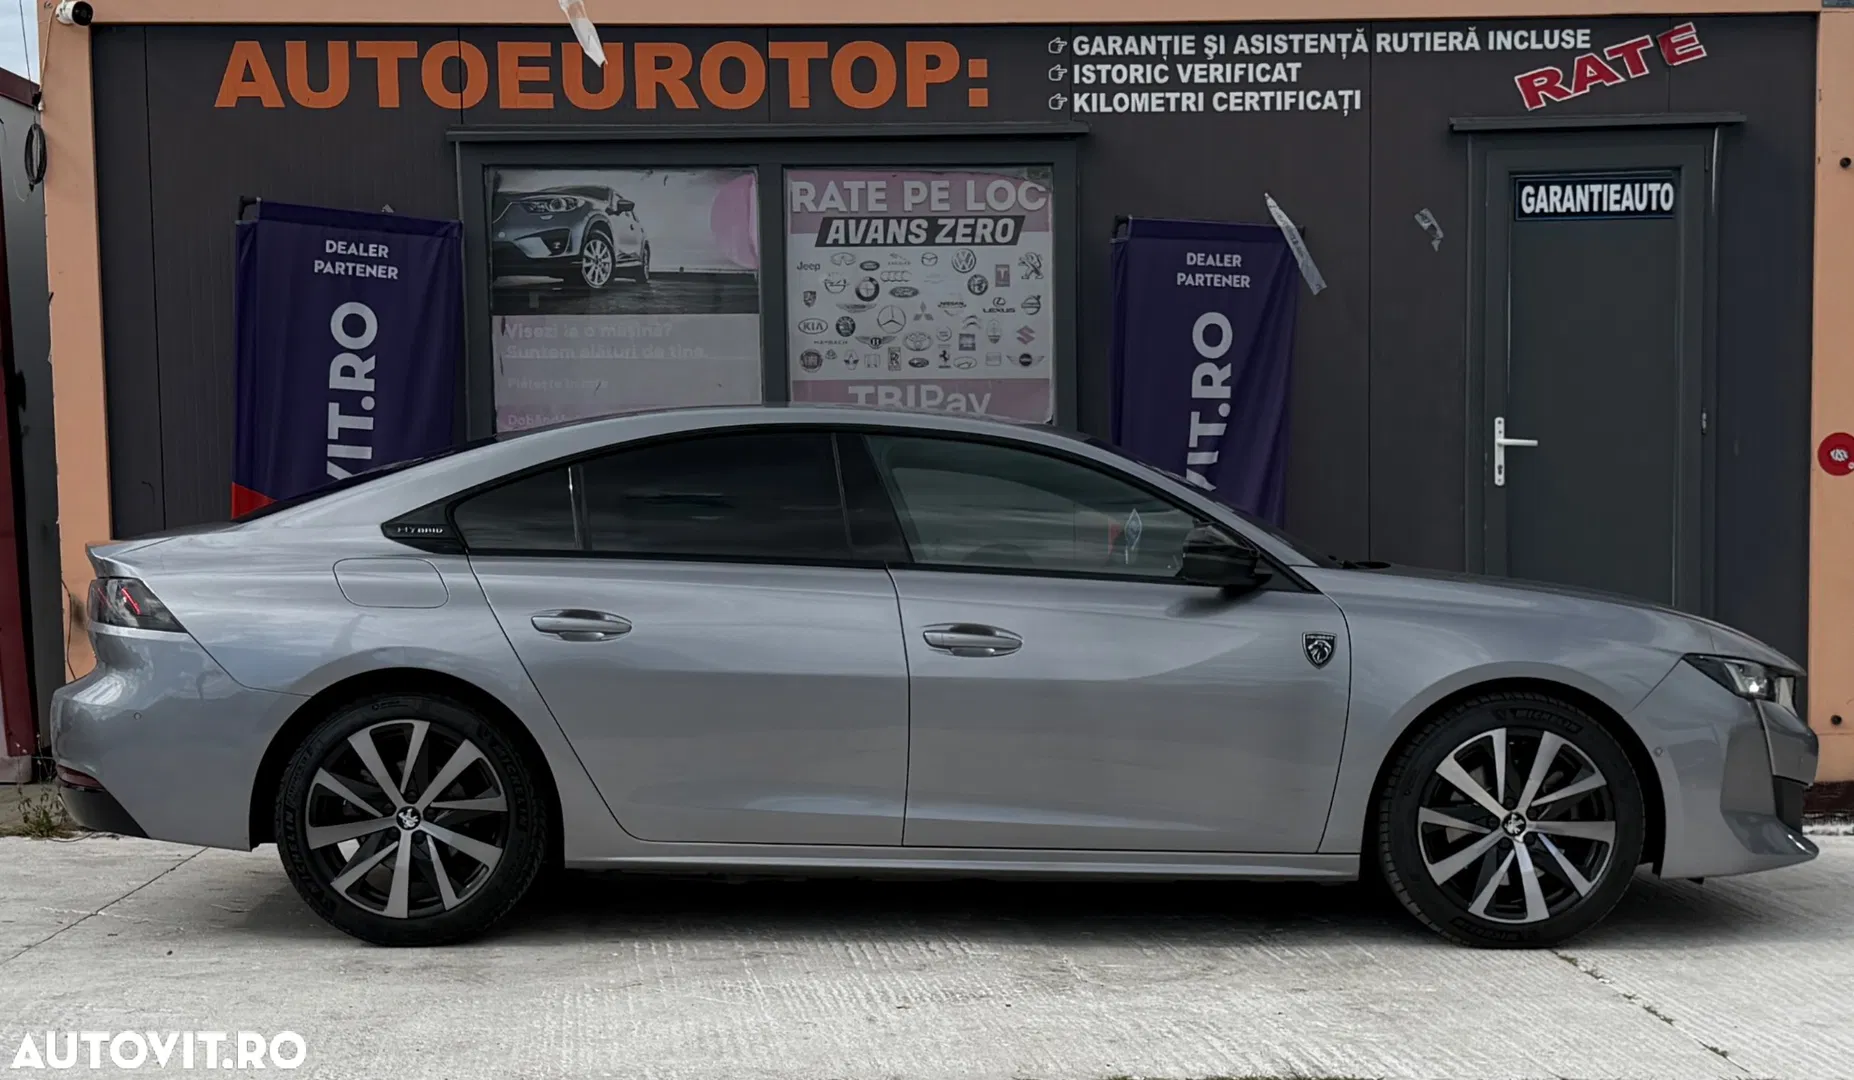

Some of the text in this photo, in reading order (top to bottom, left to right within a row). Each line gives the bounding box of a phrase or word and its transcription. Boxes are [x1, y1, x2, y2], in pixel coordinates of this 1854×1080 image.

[1073, 34, 1196, 61] GARANȚIE
[1233, 28, 1369, 60] ASISTENȚĂ
[1376, 27, 1481, 53] RUTIERĂ
[1488, 29, 1591, 50] INCLUSE
[214, 40, 988, 109] AUTOEUROTOP:
[1073, 62, 1302, 84] ISTORIC VERIFICAT
[1514, 21, 1707, 112] RATE
[1073, 90, 1361, 117] KILOMETRI CERTIFICAȚI
[791, 179, 1047, 213] RATE PE LOC
[1521, 182, 1674, 213] GARANTIEAUTO
[826, 217, 1016, 245] AVANS ZERO
[326, 240, 389, 259] DEALER
[1186, 252, 1242, 268] DEALER
[314, 260, 399, 280] PARTENER
[796, 261, 821, 271] Jeep
[1177, 272, 1251, 289] PARTENER
[803, 323, 823, 331] KIA
